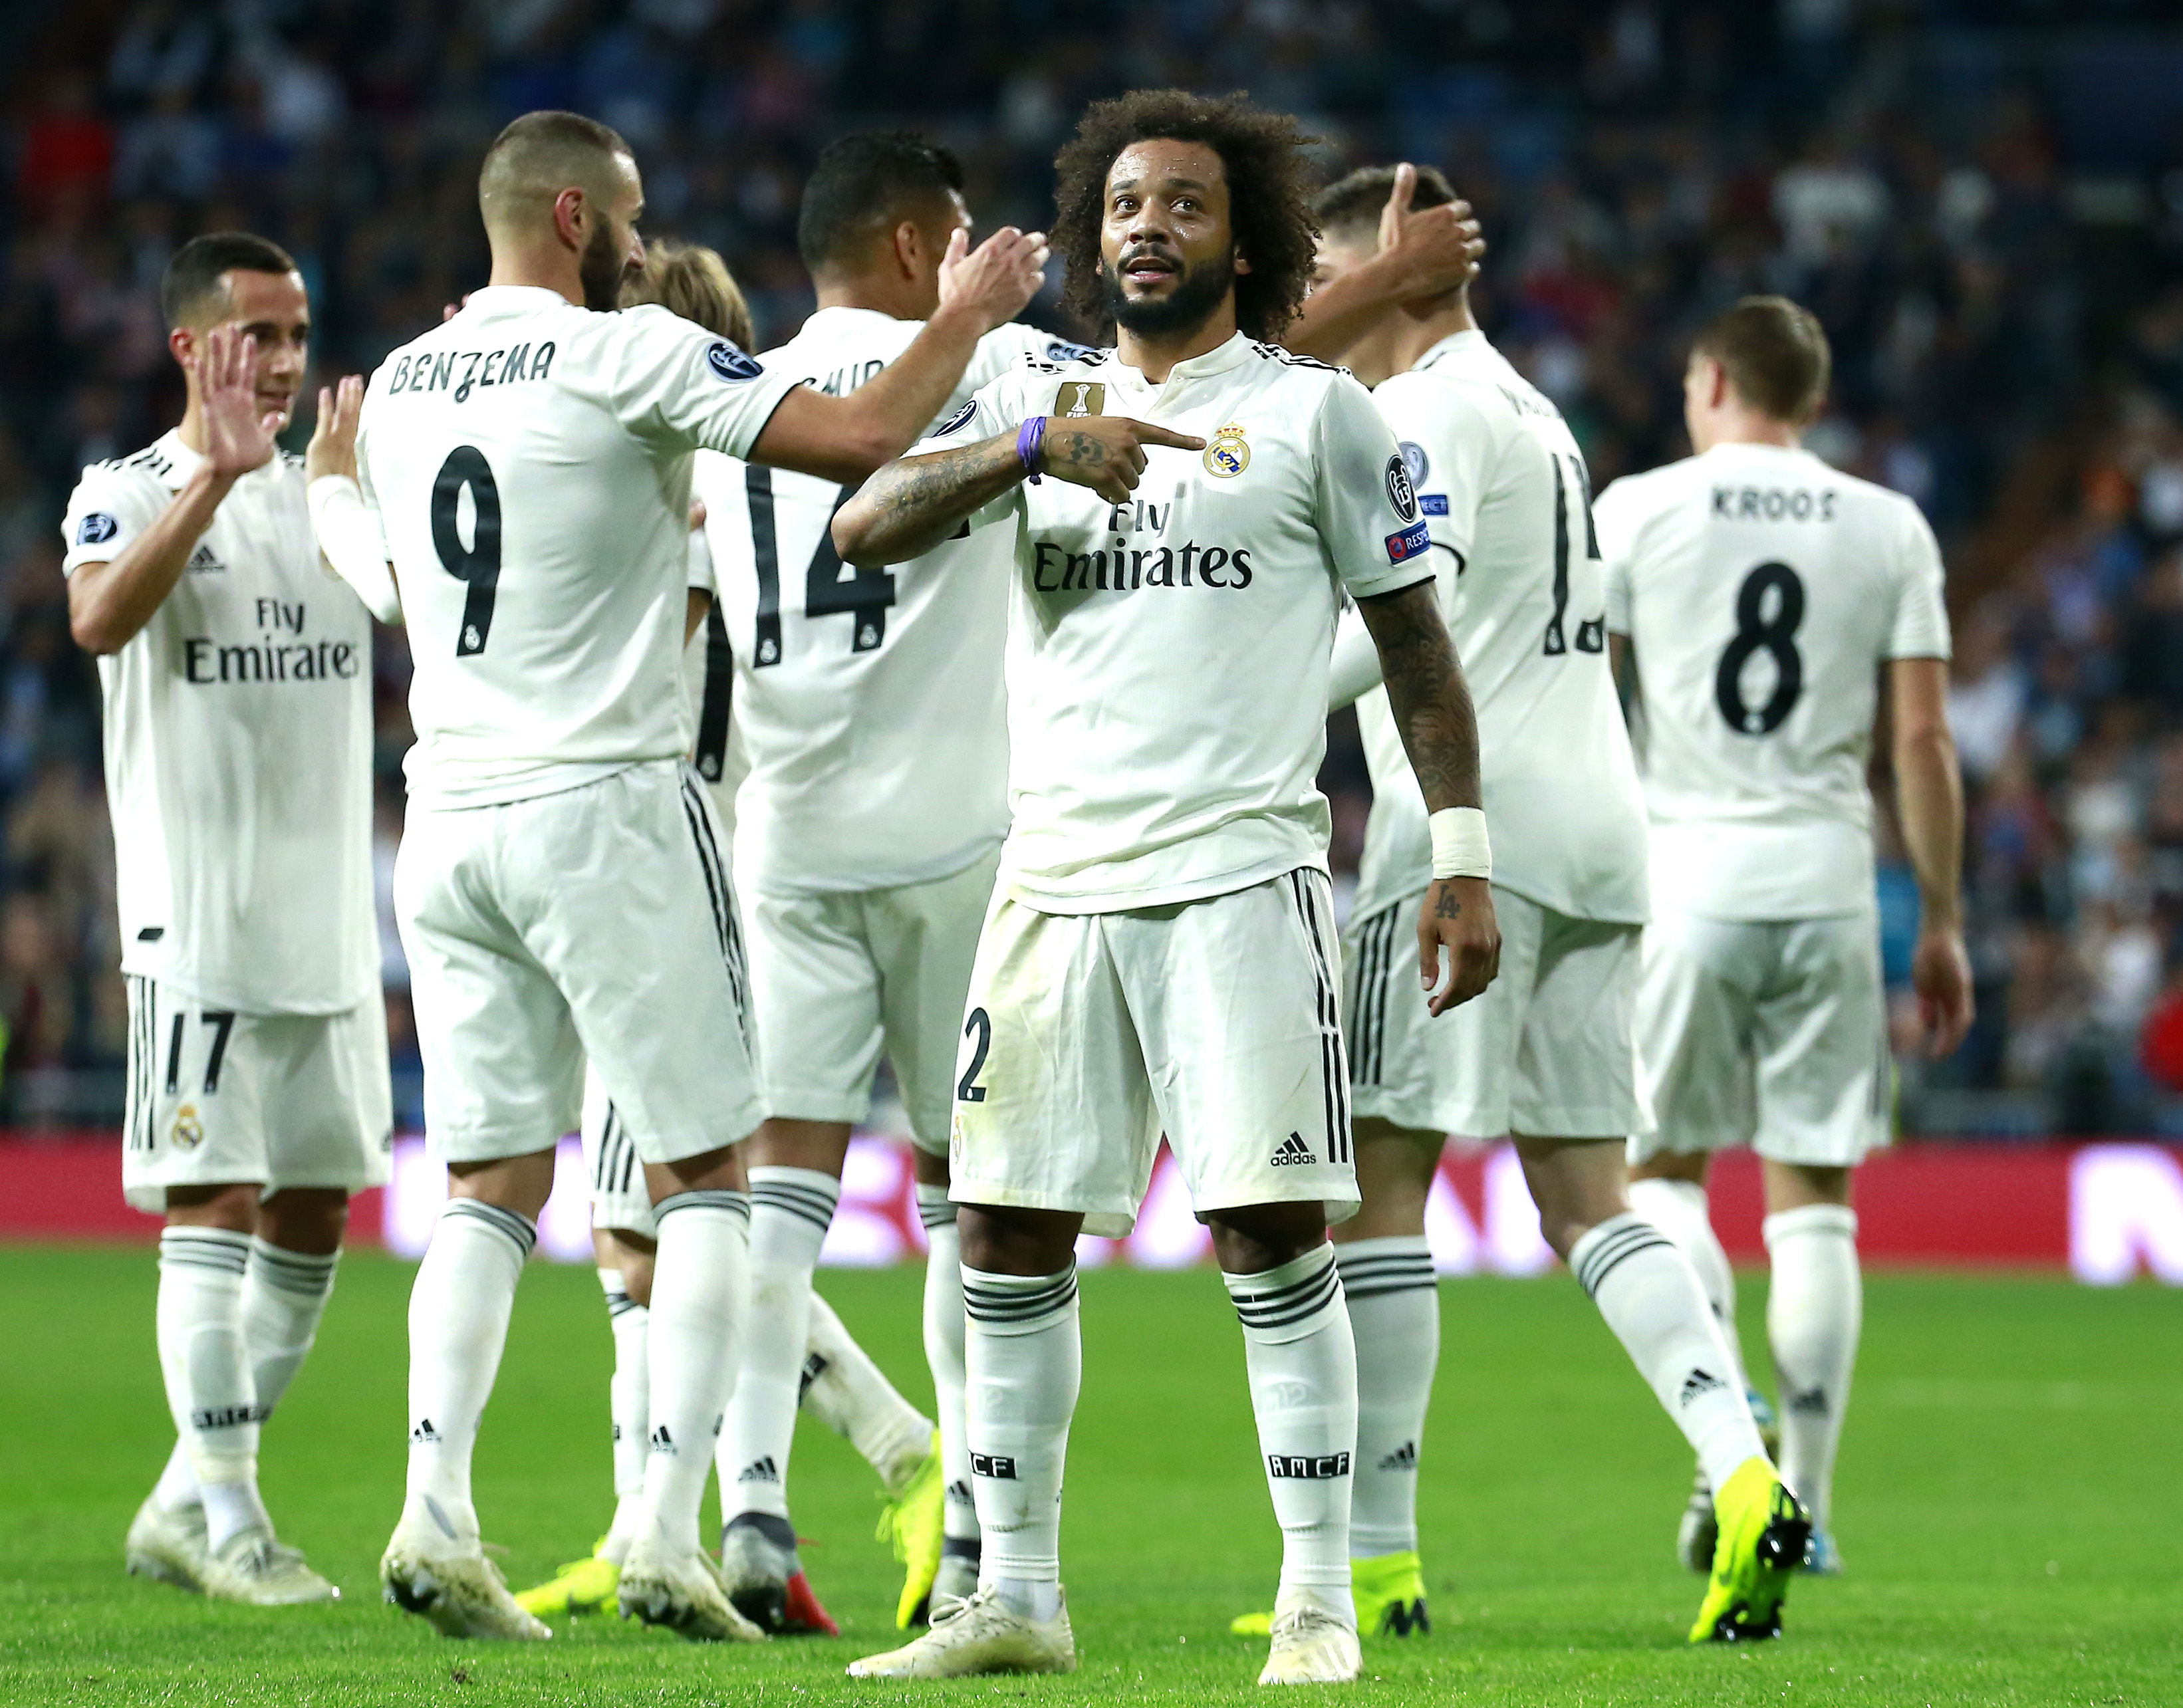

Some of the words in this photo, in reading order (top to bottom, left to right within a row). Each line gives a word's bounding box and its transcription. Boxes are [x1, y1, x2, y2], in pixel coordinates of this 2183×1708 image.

[388, 341, 556, 404] BENZEMA
[1108, 499, 1170, 539] Fly
[1711, 485, 1838, 522] KROOS
[430, 445, 502, 658] 9
[745, 461, 896, 668] 14
[1033, 538, 1253, 592] Emirates
[256, 598, 305, 634] Fly
[1716, 561, 1806, 734] 8
[166, 1011, 236, 1095] 17
[958, 1007, 991, 1103] 2
[1270, 1152, 1317, 1167] adidas
